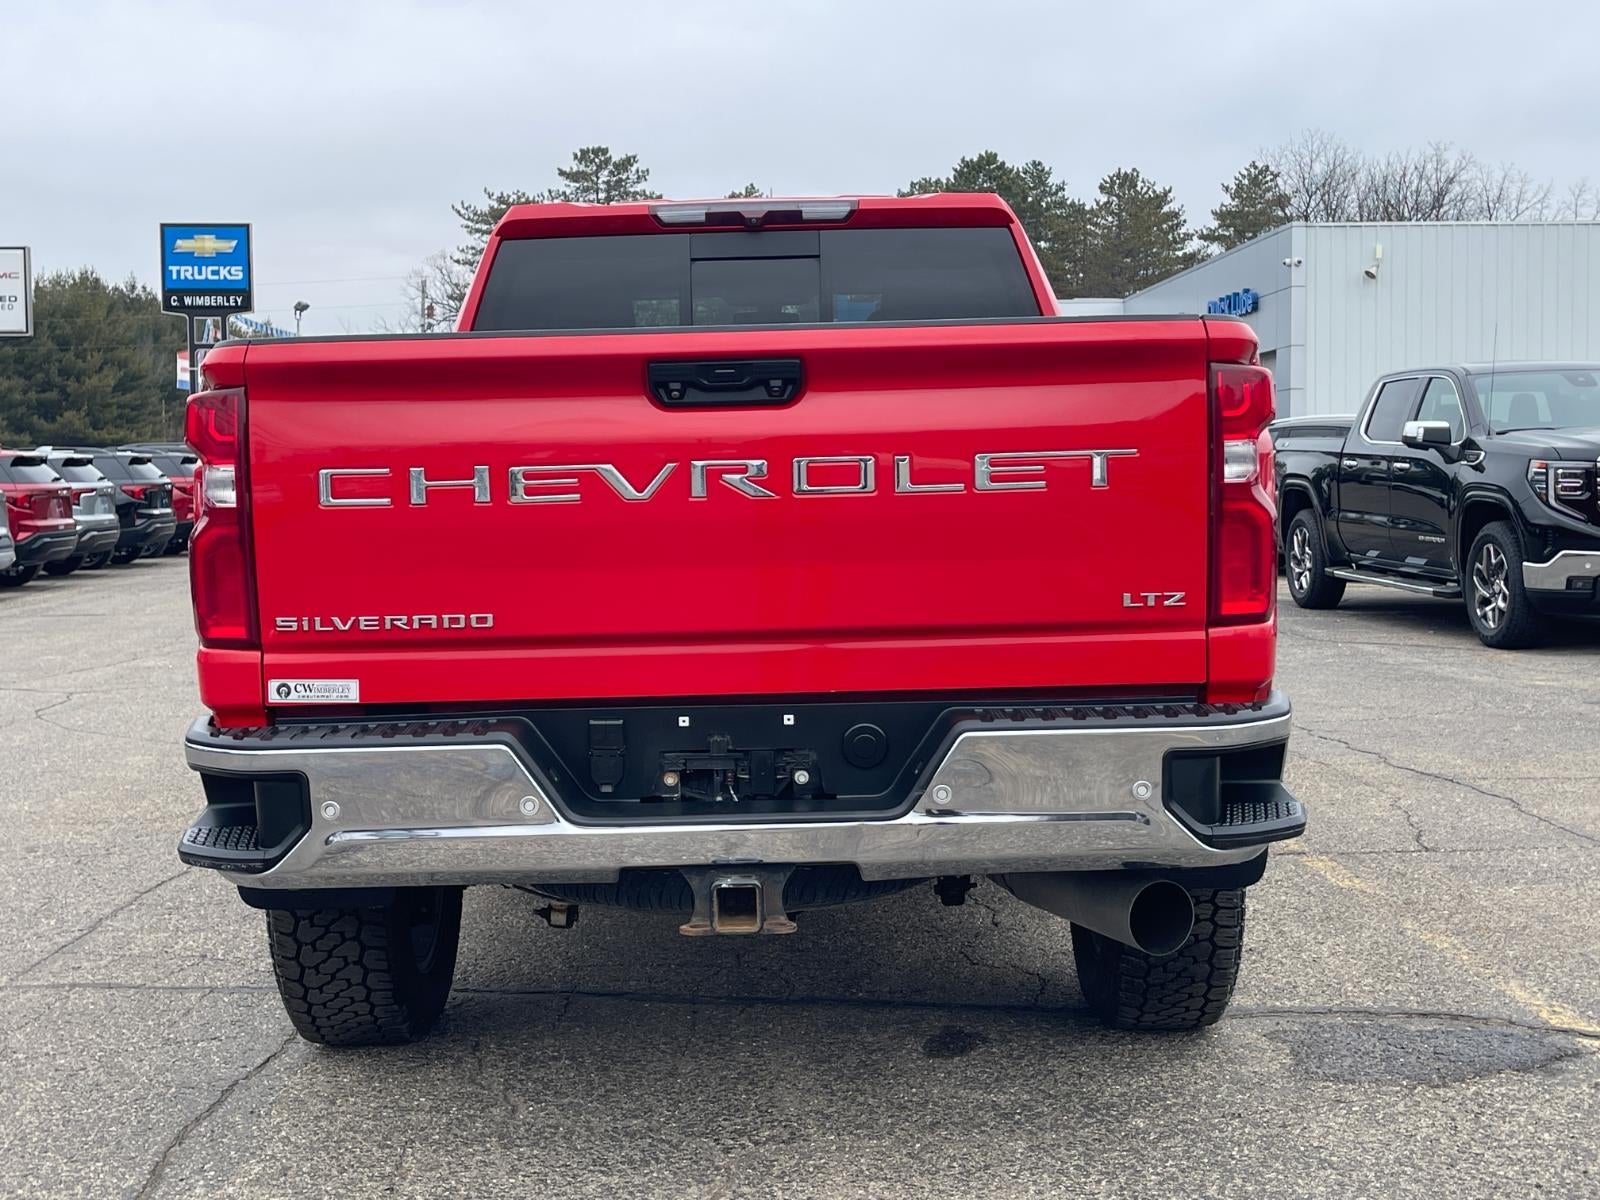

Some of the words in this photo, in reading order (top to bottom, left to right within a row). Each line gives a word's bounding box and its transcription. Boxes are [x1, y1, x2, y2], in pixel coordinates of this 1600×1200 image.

[0, 271, 20, 279] MC
[168, 265, 244, 280] TRUCKS
[183, 295, 243, 306] WIMBERLEY
[318, 448, 1139, 508] CHEVROLET
[1122, 591, 1187, 607] LTZ
